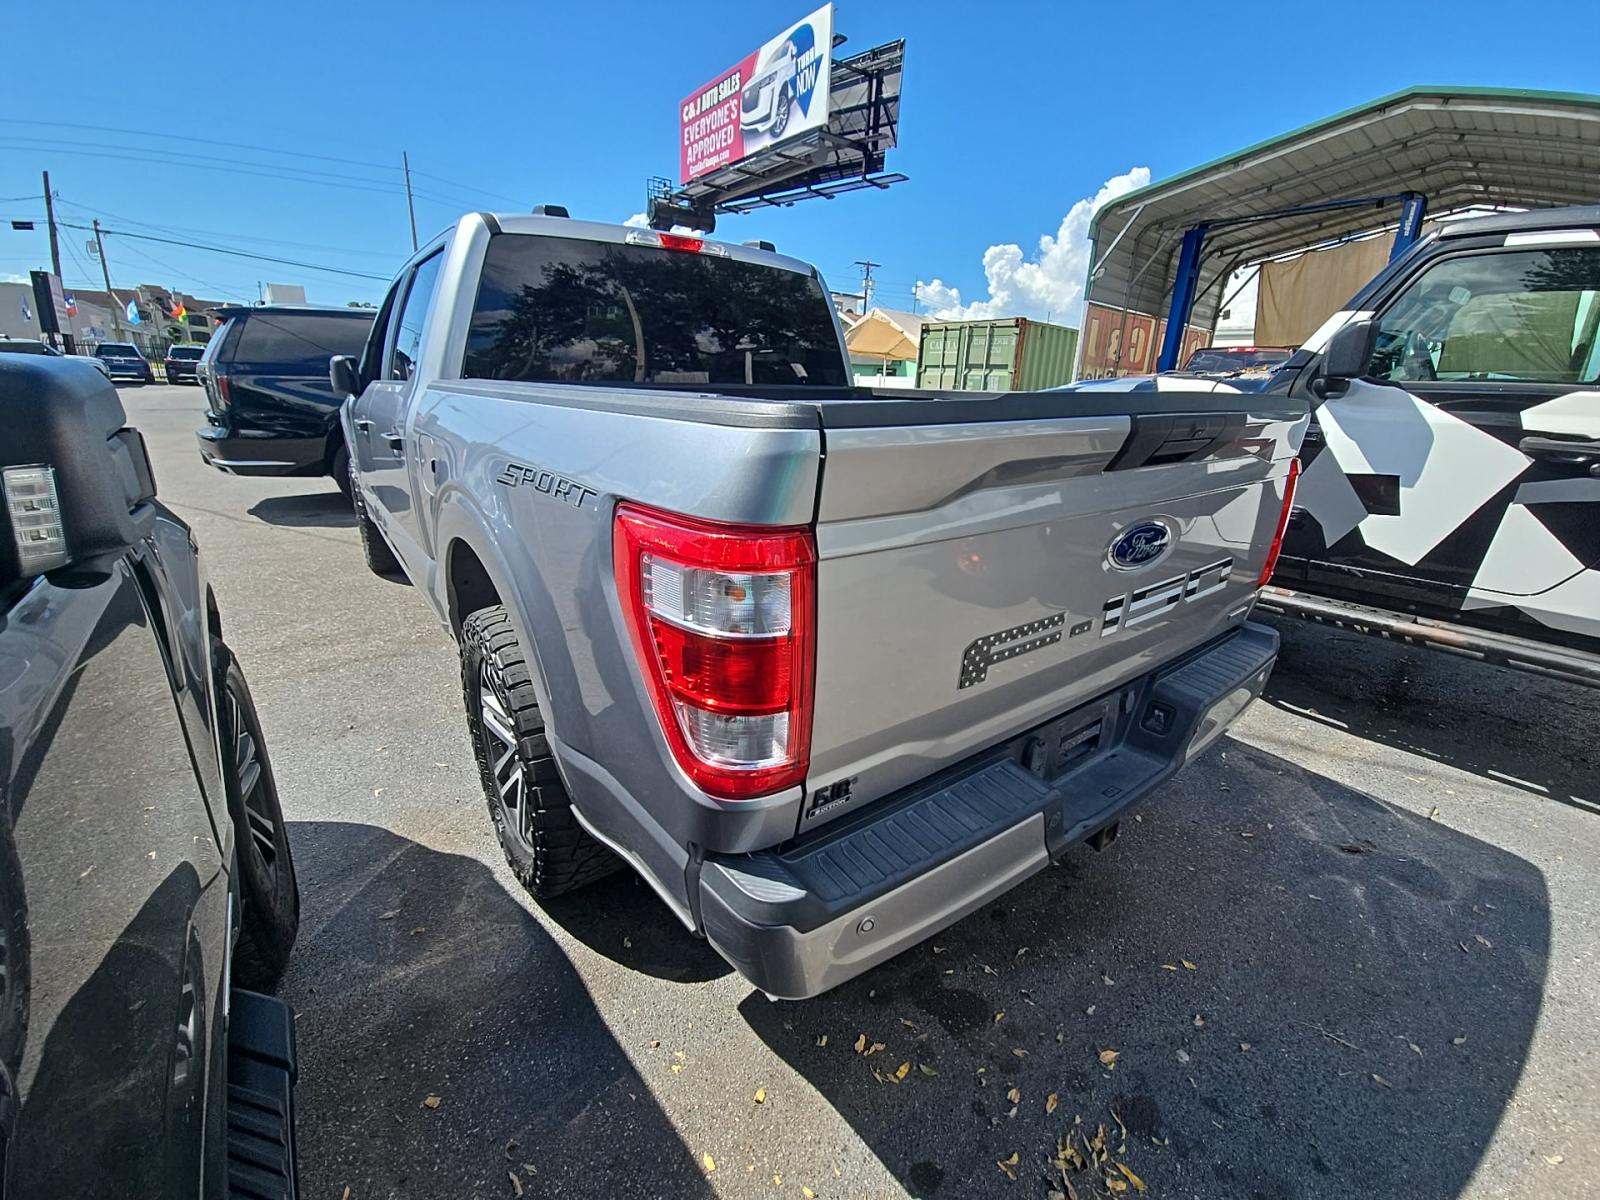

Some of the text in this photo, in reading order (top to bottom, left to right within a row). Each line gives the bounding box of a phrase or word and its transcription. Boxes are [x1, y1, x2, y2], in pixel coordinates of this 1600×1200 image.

[701, 85, 719, 112] AUTO
[719, 72, 740, 101] SALES
[797, 62, 816, 98] NOW
[684, 99, 738, 146] EVERYONE'S
[687, 124, 734, 165] APPROVED
[496, 462, 598, 508] SPORT
